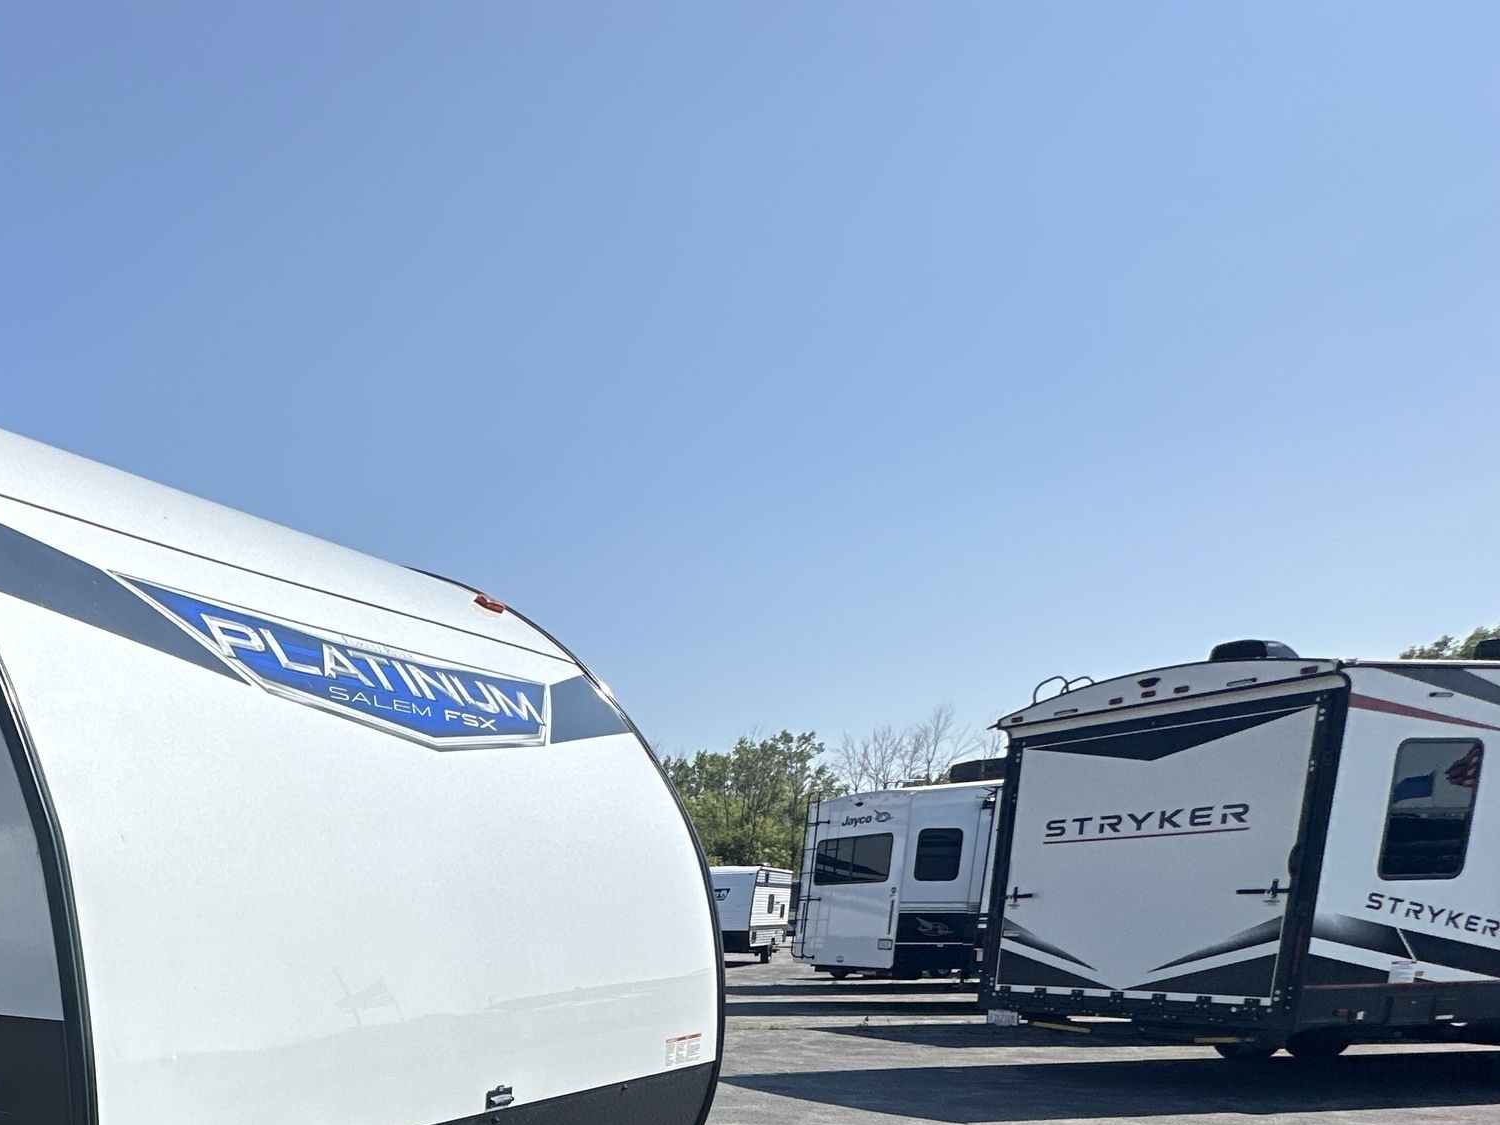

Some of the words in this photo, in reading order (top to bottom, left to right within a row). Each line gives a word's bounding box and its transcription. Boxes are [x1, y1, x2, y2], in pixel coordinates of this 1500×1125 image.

[201, 613, 546, 725] PLATINUM
[328, 686, 432, 718] SALEM
[444, 709, 498, 731] FSX
[841, 815, 872, 827] Jayco
[1045, 803, 1250, 838] STRYKER
[1365, 892, 1500, 937] STRYKER
